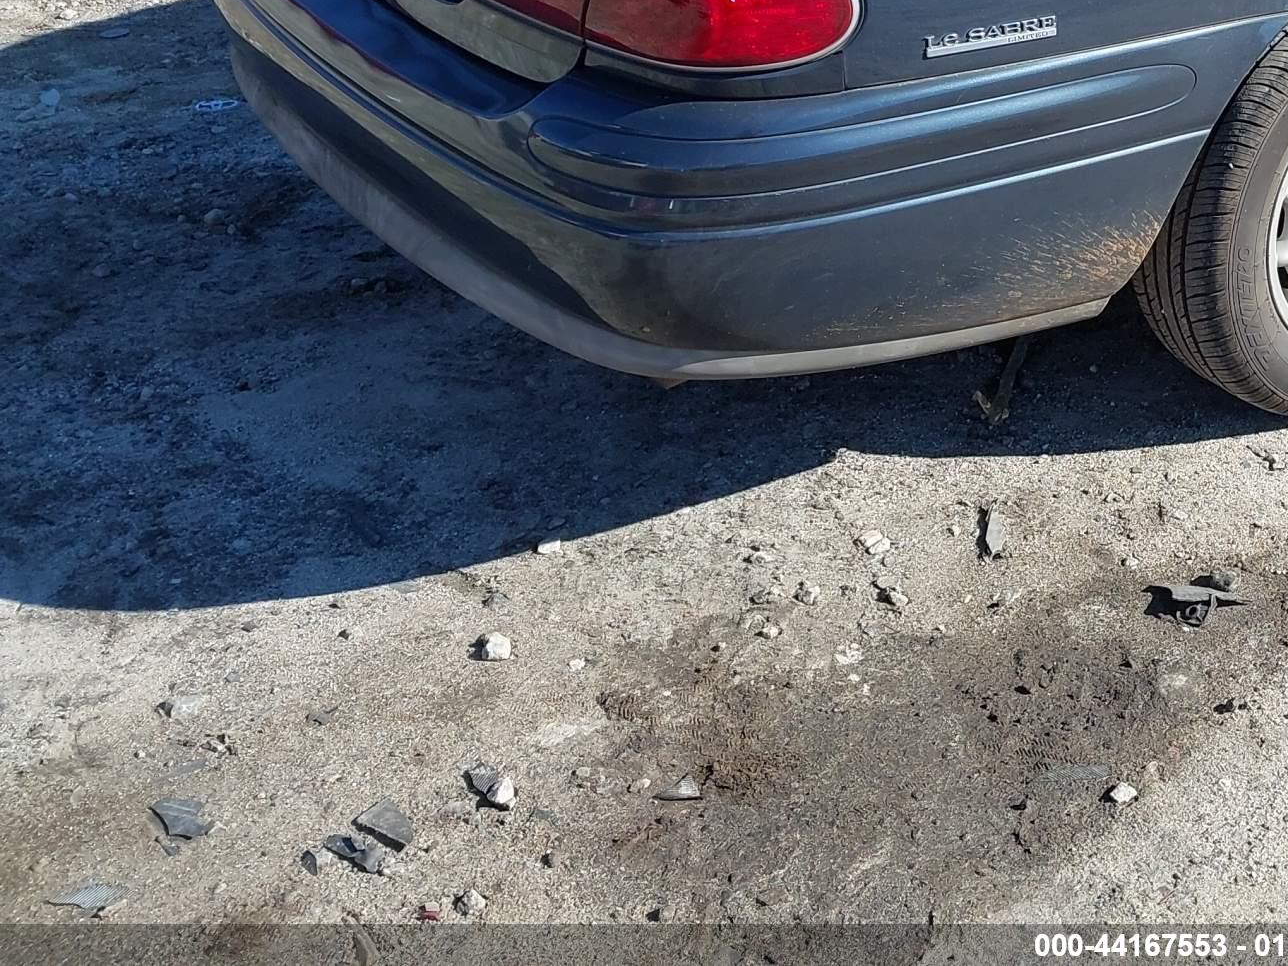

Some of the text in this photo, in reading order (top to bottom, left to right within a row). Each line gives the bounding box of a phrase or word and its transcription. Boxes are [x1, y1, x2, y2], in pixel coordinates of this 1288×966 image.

[924, 15, 1056, 50] Le SABRE
[1007, 31, 1049, 43] LIMITED
